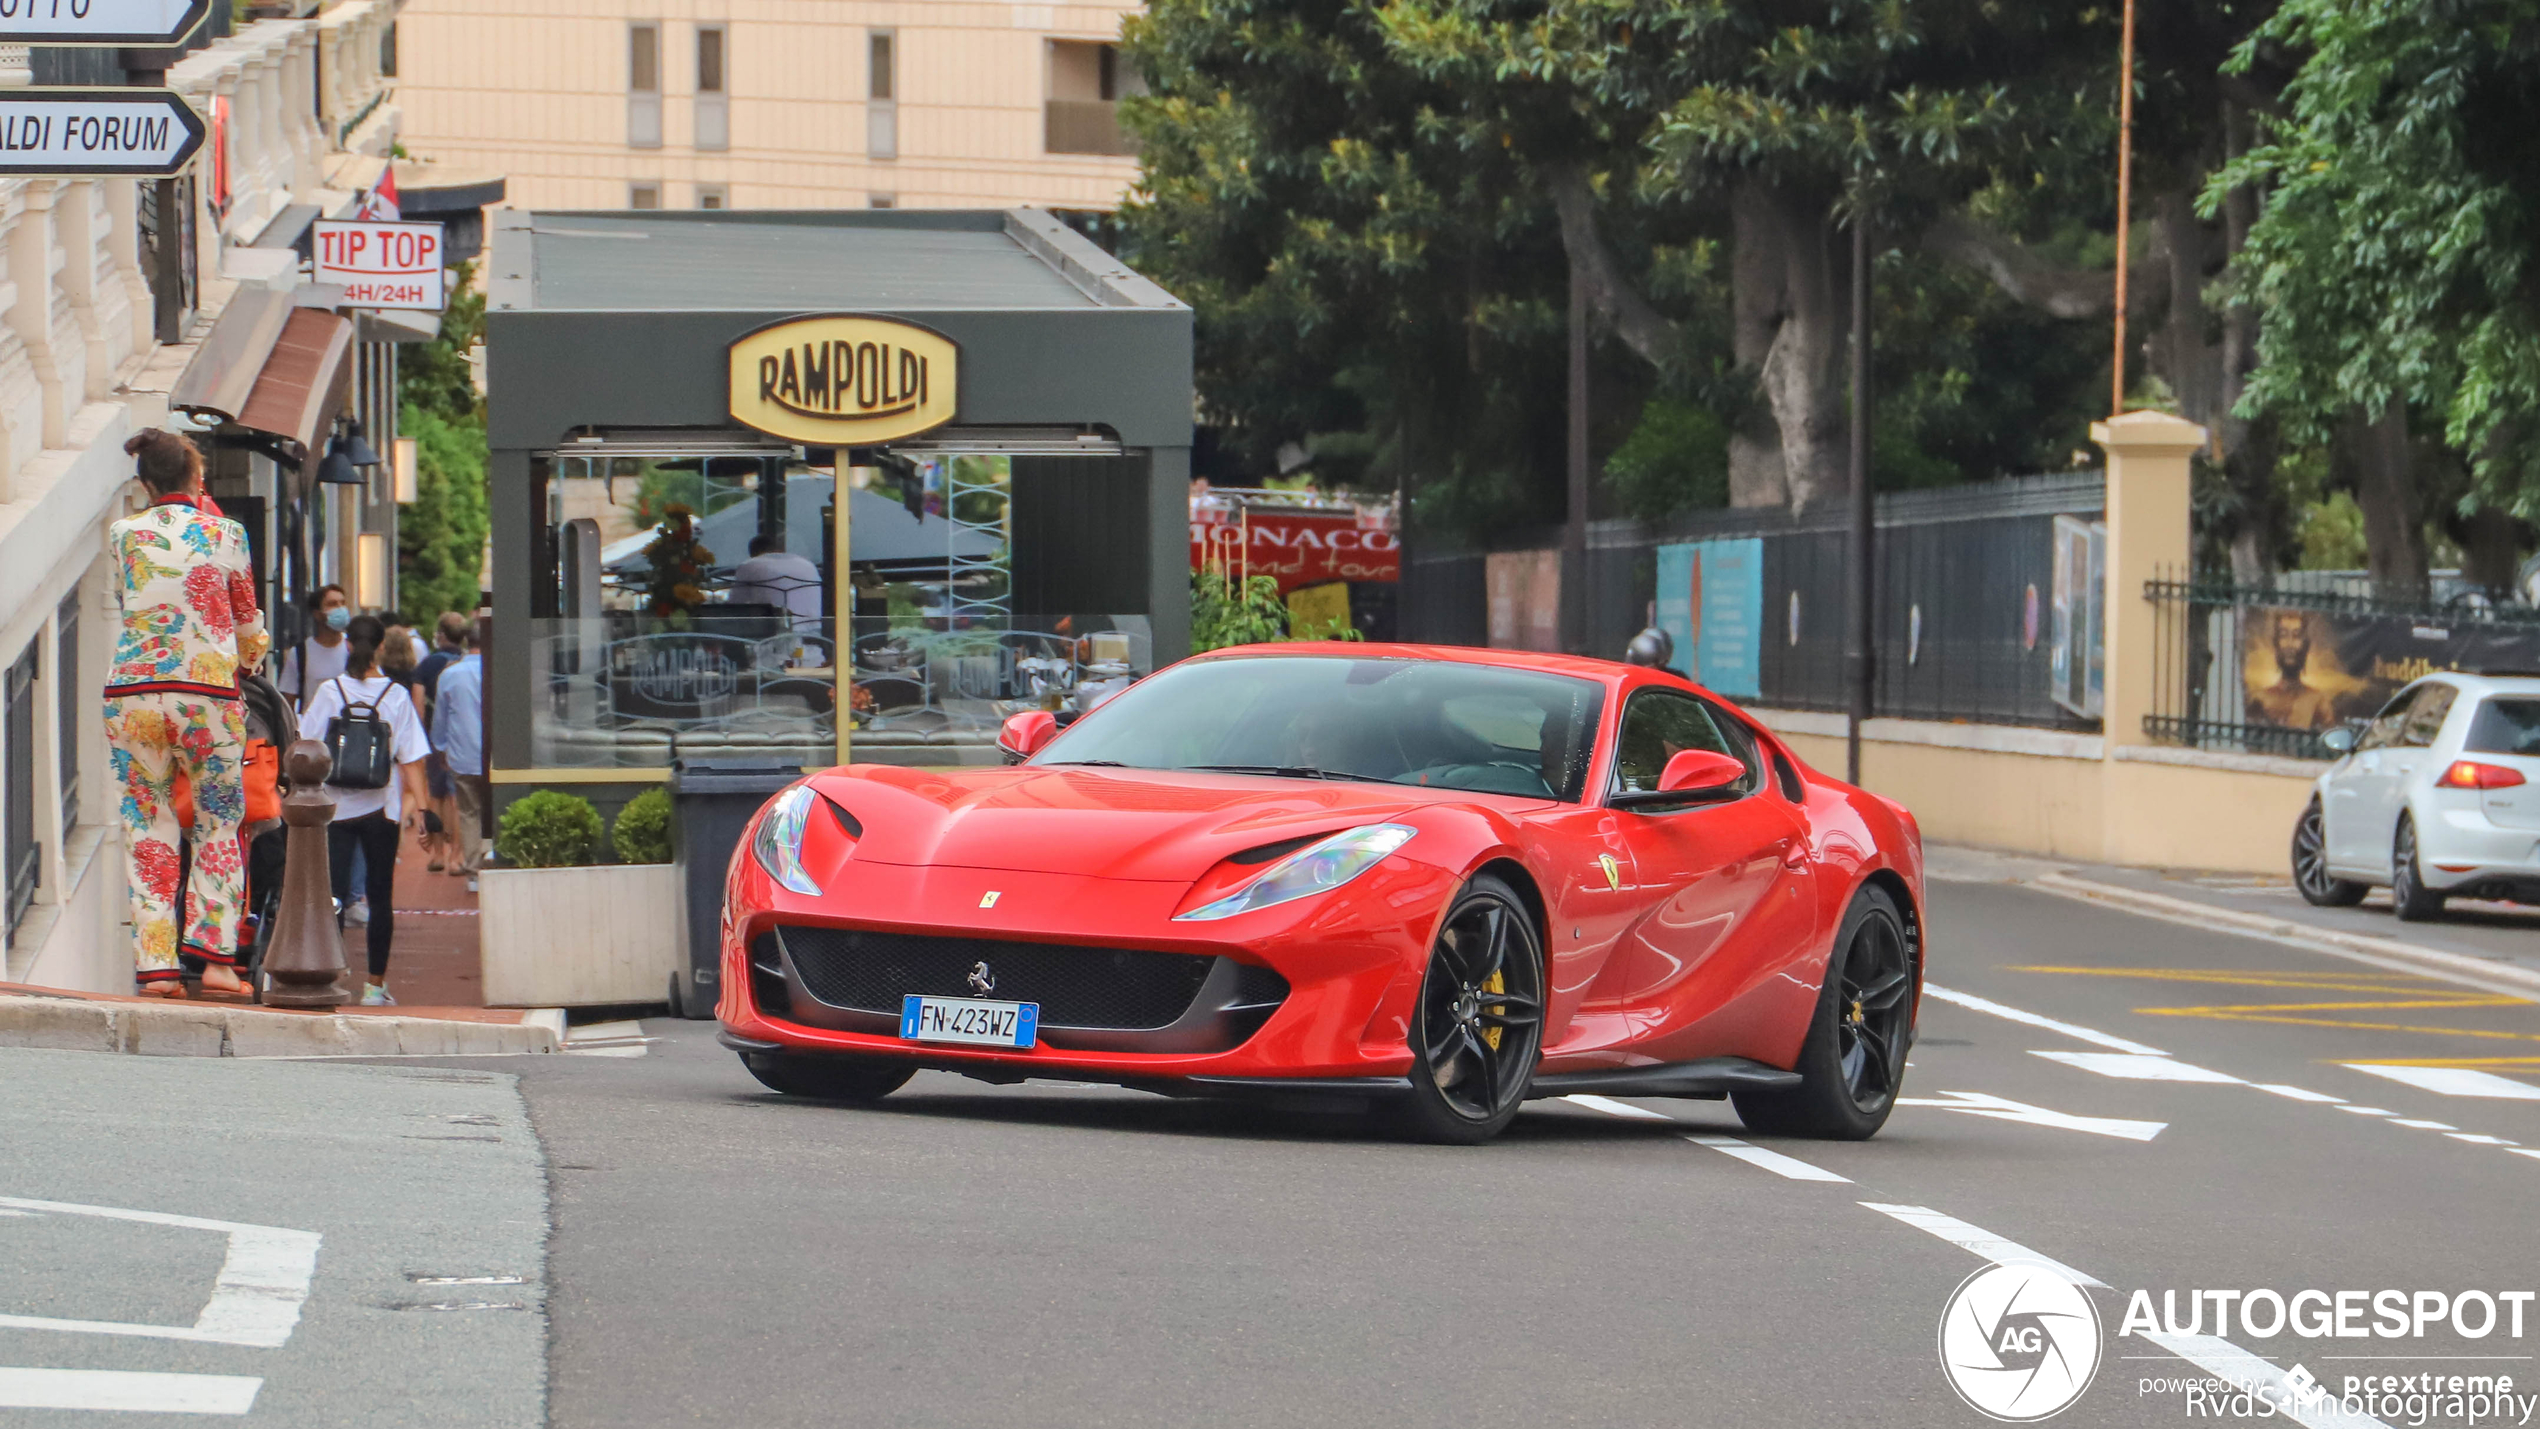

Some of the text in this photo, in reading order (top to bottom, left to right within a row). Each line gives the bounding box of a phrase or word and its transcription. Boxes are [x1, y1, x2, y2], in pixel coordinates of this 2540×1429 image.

[0, 116, 169, 151] LDI FORUM
[319, 231, 435, 268] TIP TOP
[342, 284, 423, 302] 4H/24H
[760, 340, 927, 421] RAMPOLDI
